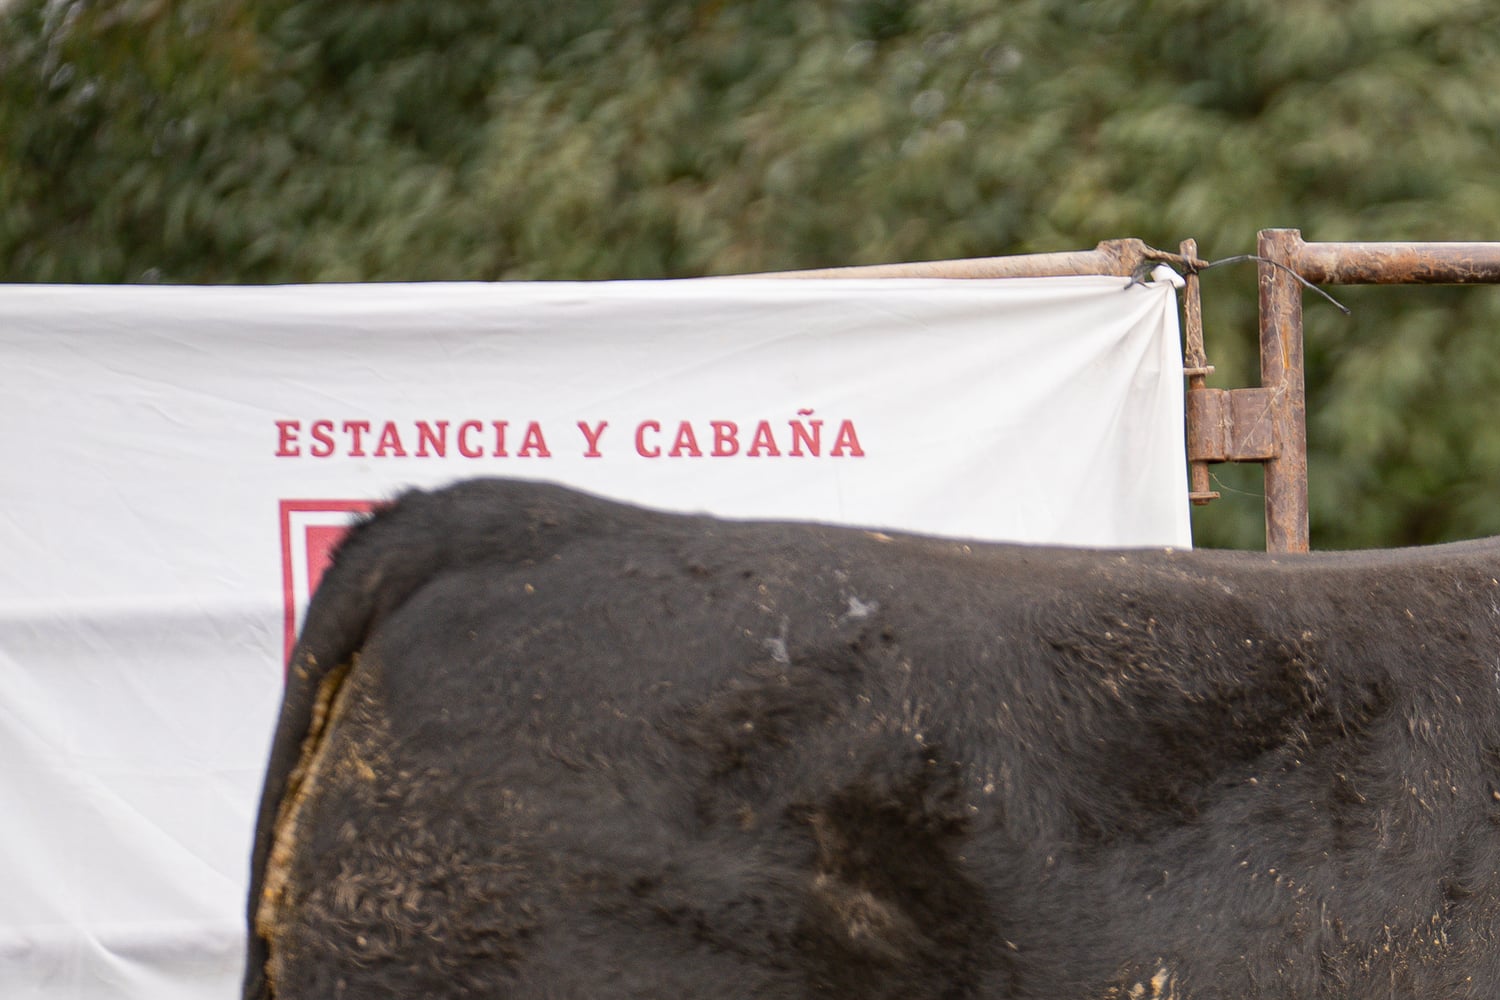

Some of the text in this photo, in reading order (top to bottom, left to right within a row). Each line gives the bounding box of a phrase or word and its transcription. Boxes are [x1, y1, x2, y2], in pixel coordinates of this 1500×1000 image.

[275, 408, 865, 458] ESTANCIA Y CABAÑA
